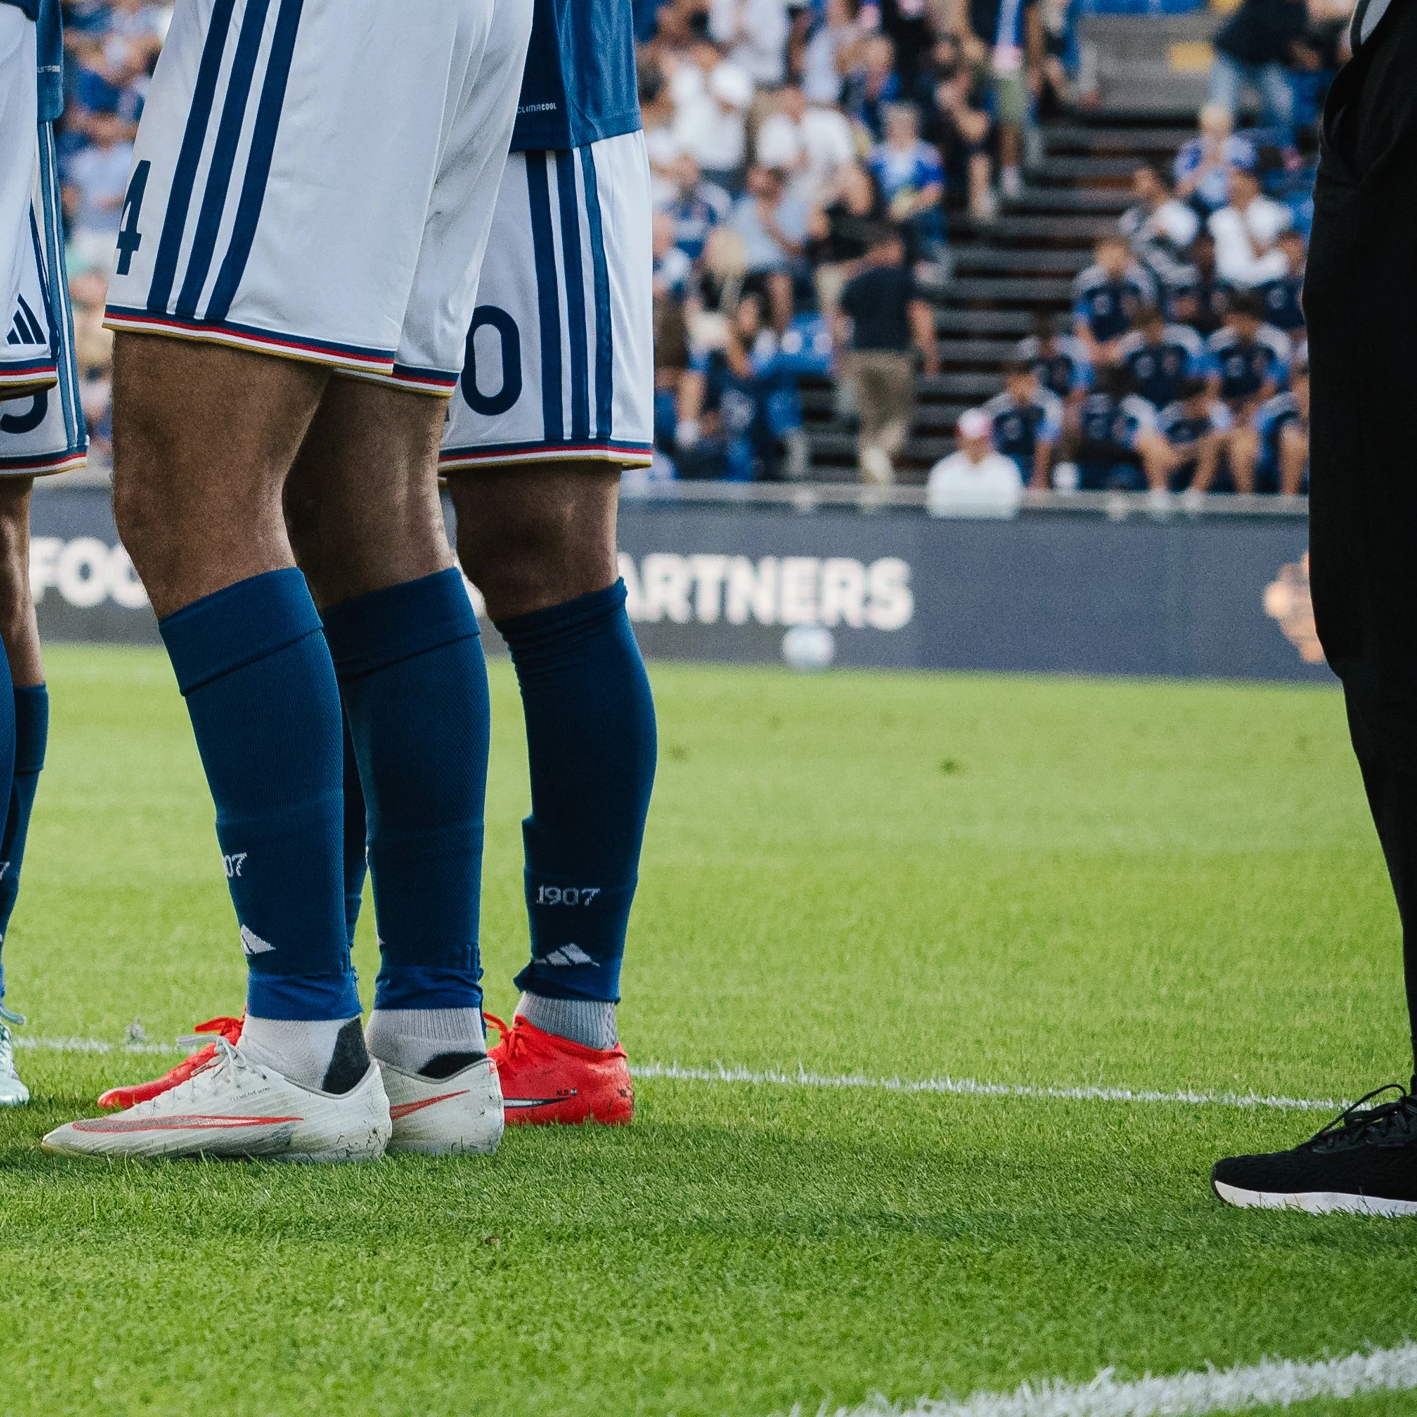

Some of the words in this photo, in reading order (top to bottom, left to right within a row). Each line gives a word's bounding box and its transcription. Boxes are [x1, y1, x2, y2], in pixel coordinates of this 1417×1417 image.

[445, 305, 522, 422] 0
[618, 551, 915, 631] ARTNERS
[536, 885, 601, 907] 1907
